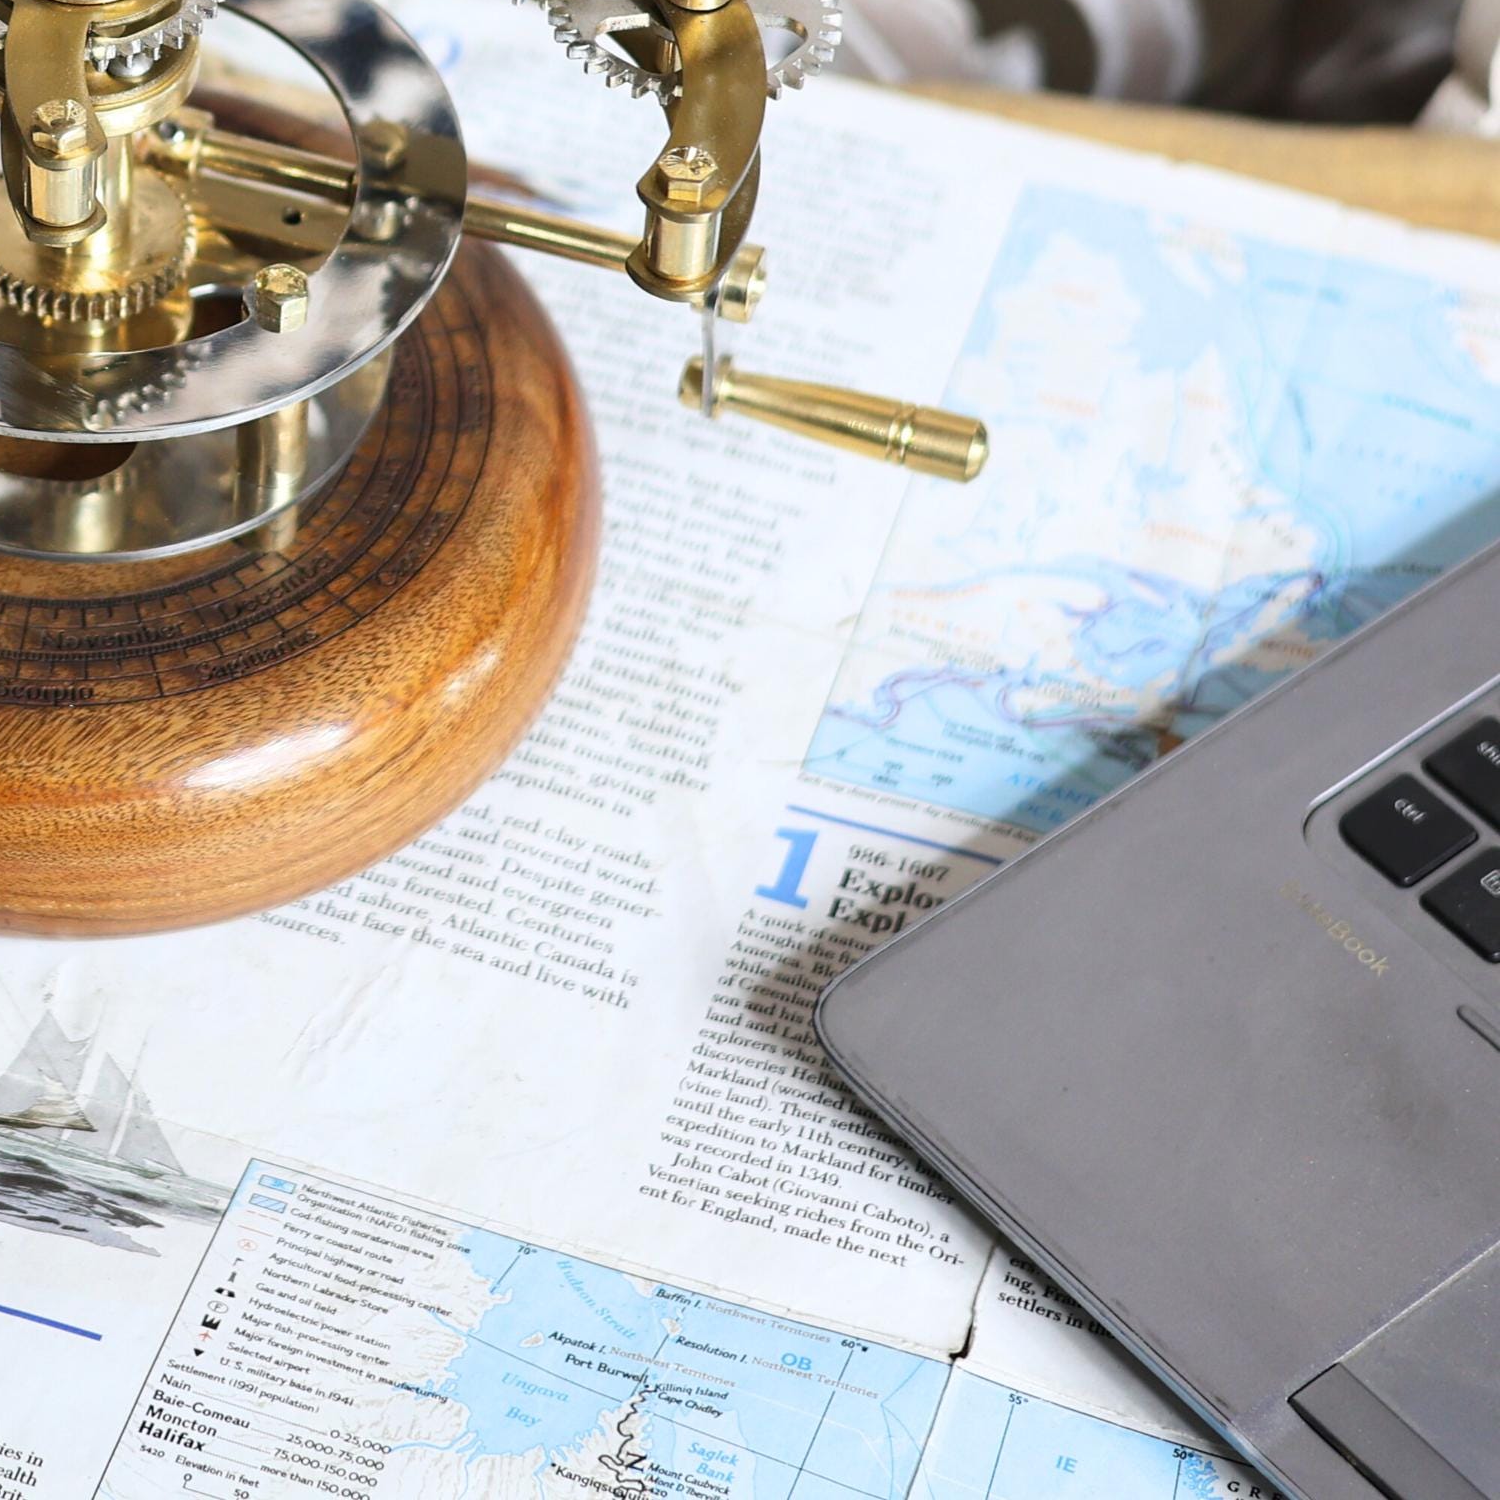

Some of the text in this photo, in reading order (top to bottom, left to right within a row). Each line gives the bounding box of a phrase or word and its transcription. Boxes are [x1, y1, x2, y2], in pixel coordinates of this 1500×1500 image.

[41, 620, 186, 650] November
[194, 627, 320, 681] Sagittarius
[1394, 799, 1426, 825] ctrl
[755, 827, 819, 910] 1
[849, 843, 951, 882] 986-1607
[315, 901, 631, 1011] that face the sea and live with
[300, 1183, 448, 1237] Northwest Atlantic Fisheries
[648, 1162, 966, 1266] Venetian seeking riches from the Ori-
[669, 1150, 951, 1245] John Cabot (Giovanni Caboto), a
[283, 1221, 394, 1265] Ferry or coastal route
[290, 1206, 434, 1261] Cod-fishing moratorium area
[262, 1266, 390, 1315] Northern Labrador Store
[557, 1259, 637, 1340] Hudson Strait
[997, 1290, 1084, 1331] settlers in
[548, 1331, 597, 1354] Akpatok
[610, 1346, 670, 1369] Northwest
[674, 1363, 736, 1388] Territories
[564, 1353, 649, 1384] Port Burwell
[781, 1352, 812, 1371] OB
[501, 1372, 570, 1402] Ungava
[152, 1388, 386, 1471] Baie-Comeau 25,000-75,000
[160, 1372, 392, 1455] Nain 0-25,000
[504, 1406, 542, 1427] Bay
[24, 1450, 45, 1469] in
[138, 1420, 205, 1453] Halifax
[260, 1464, 287, 1481] more
[290, 1470, 314, 1488] than
[145, 1404, 379, 1488] Moncton 75,000-150,000
[688, 1442, 740, 1467] Saglek
[1056, 1455, 1078, 1474] IE
[697, 1463, 736, 1484] Bank
